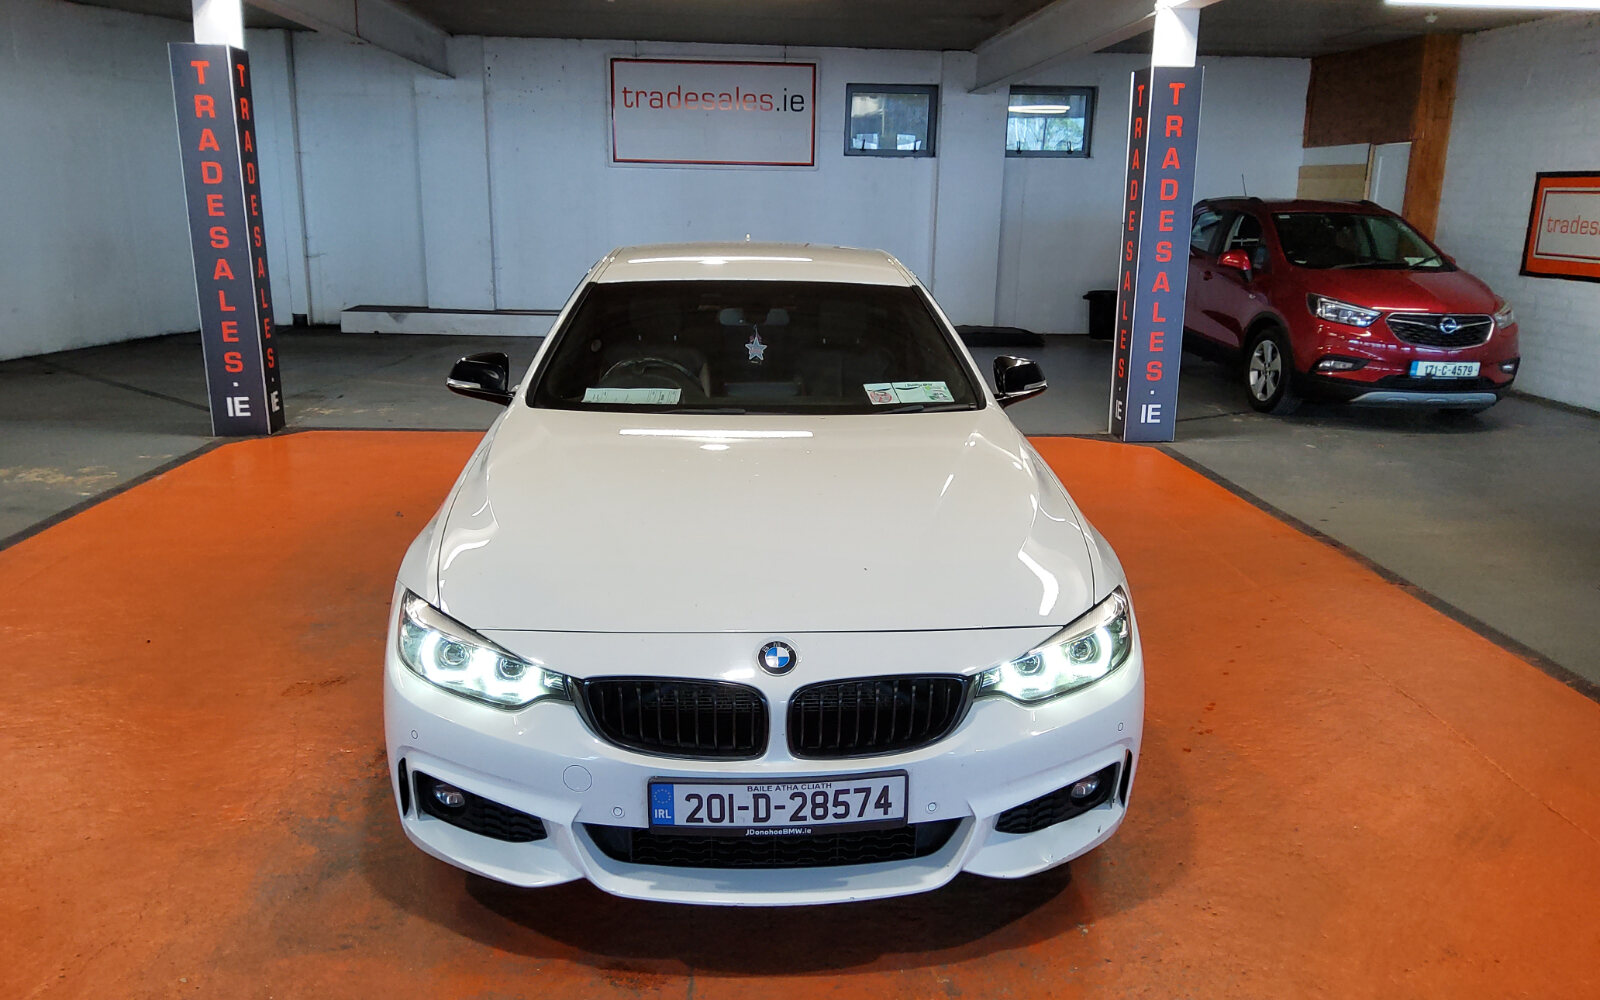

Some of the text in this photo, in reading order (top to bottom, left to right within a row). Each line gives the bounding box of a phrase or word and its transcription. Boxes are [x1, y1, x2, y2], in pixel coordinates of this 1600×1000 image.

[621, 85, 805, 112] tradesales.ie
[1546, 215, 1600, 236] trades
[801, 782, 832, 790] CLIATH
[654, 808, 672, 820] IRL
[684, 784, 893, 824] 201-D-28574
